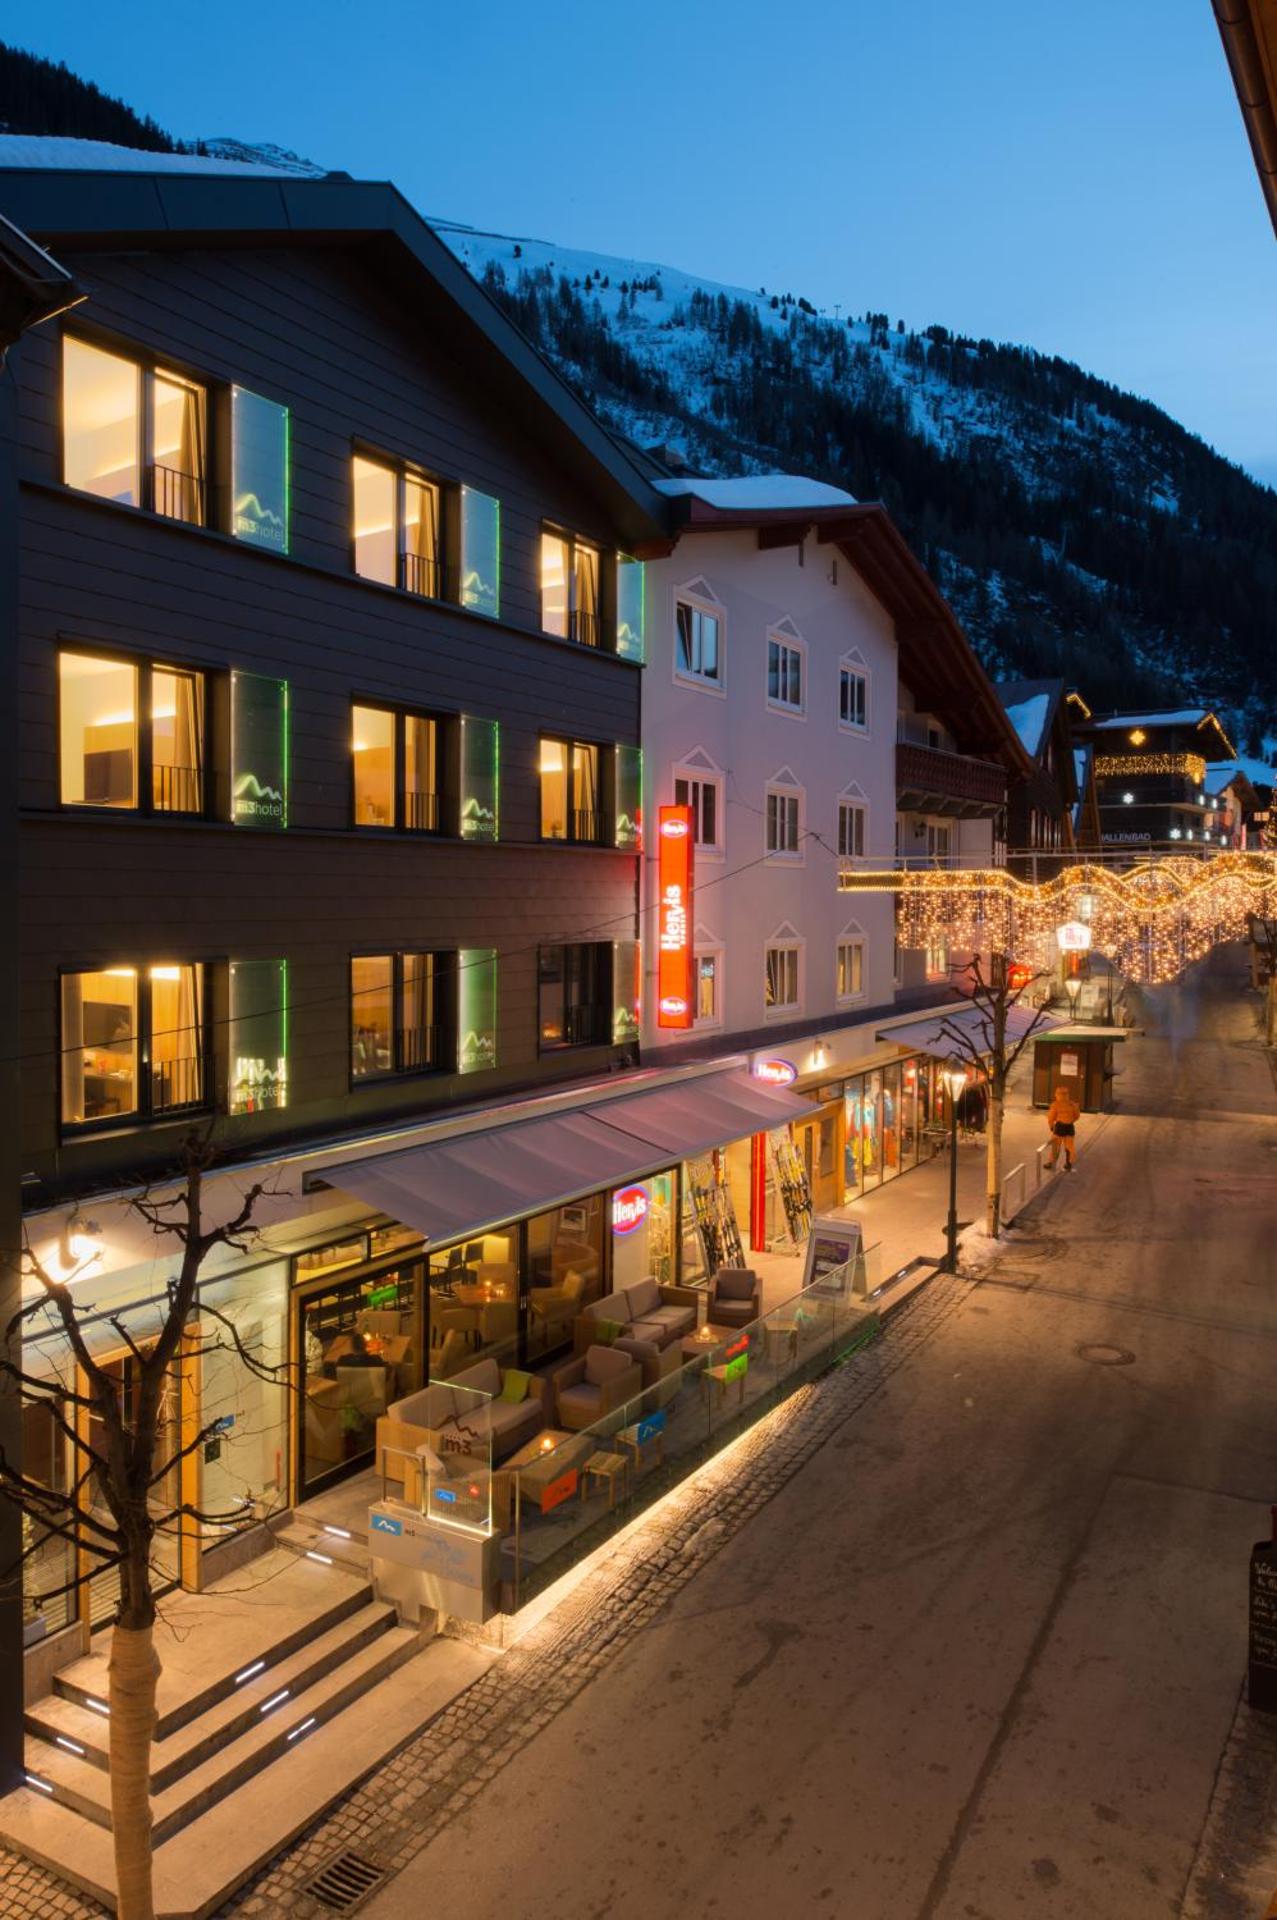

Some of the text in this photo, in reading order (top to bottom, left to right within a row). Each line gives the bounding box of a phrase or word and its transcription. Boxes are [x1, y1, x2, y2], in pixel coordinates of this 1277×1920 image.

[236, 800, 282, 816] m3hotel
[661, 885, 684, 949] Hervis
[758, 1064, 792, 1081] Hervis
[613, 1196, 646, 1225] Hervis
[446, 1439, 472, 1455] m3
